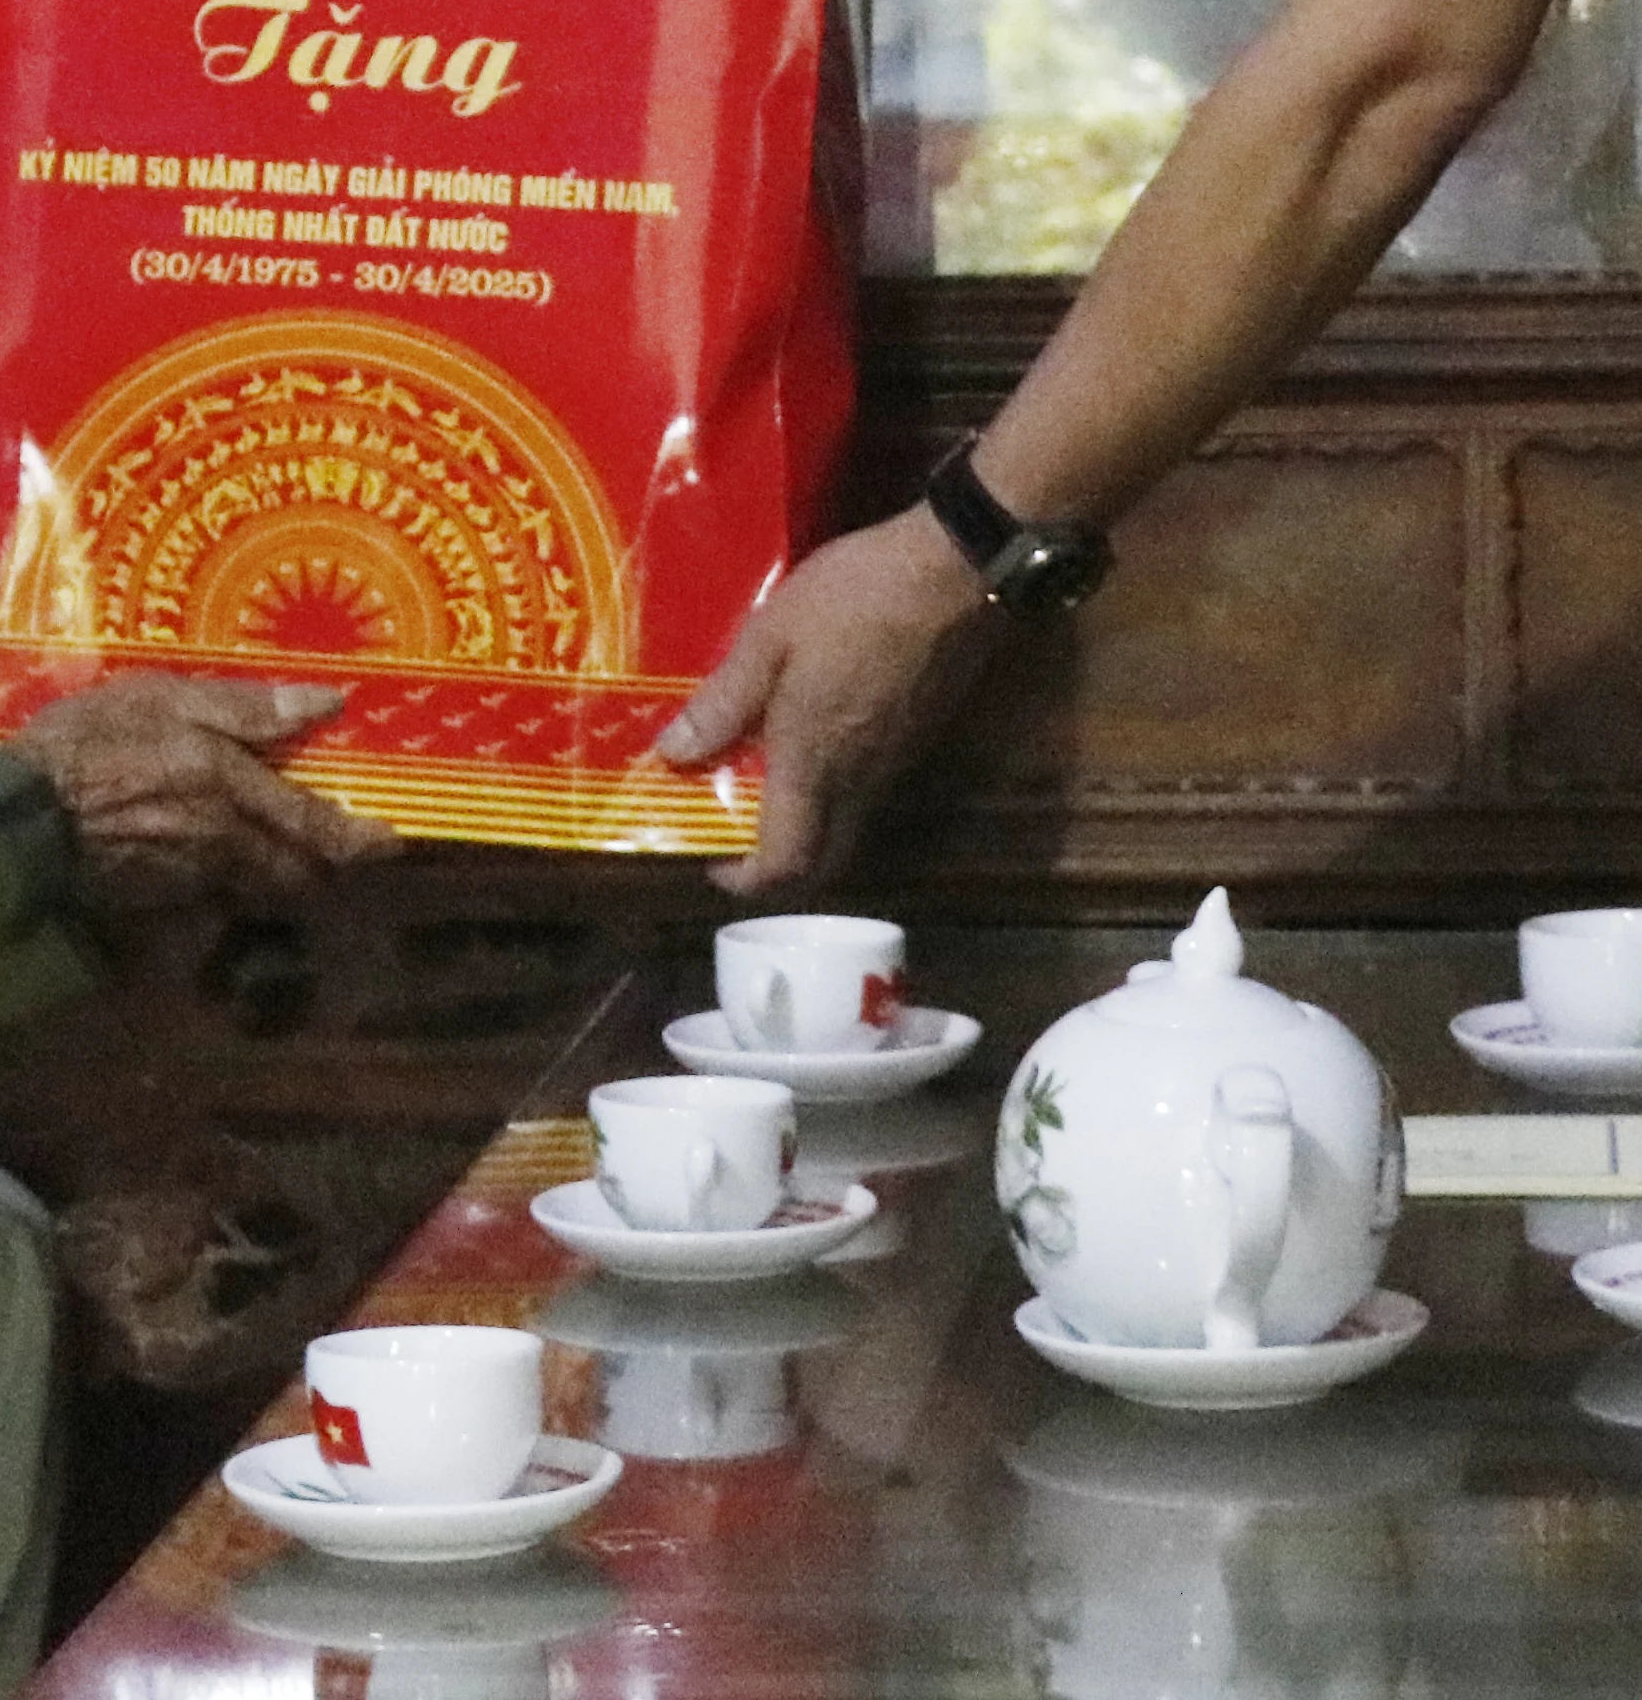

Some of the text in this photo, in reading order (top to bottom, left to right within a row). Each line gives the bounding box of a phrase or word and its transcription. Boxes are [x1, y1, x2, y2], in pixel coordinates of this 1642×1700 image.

[62, 146, 139, 191] NIỆM
[145, 155, 182, 188] 50
[187, 153, 256, 192] NĂM
[262, 157, 341, 196] NGÀY
[347, 155, 407, 199] GIẢI
[412, 165, 512, 206] PHÓNG
[182, 197, 510, 255] THỐNG NHẤT ĐẤT NƯỚC
[130, 247, 320, 288] (30/4/1975
[354, 260, 554, 307] 30/4/2025)
